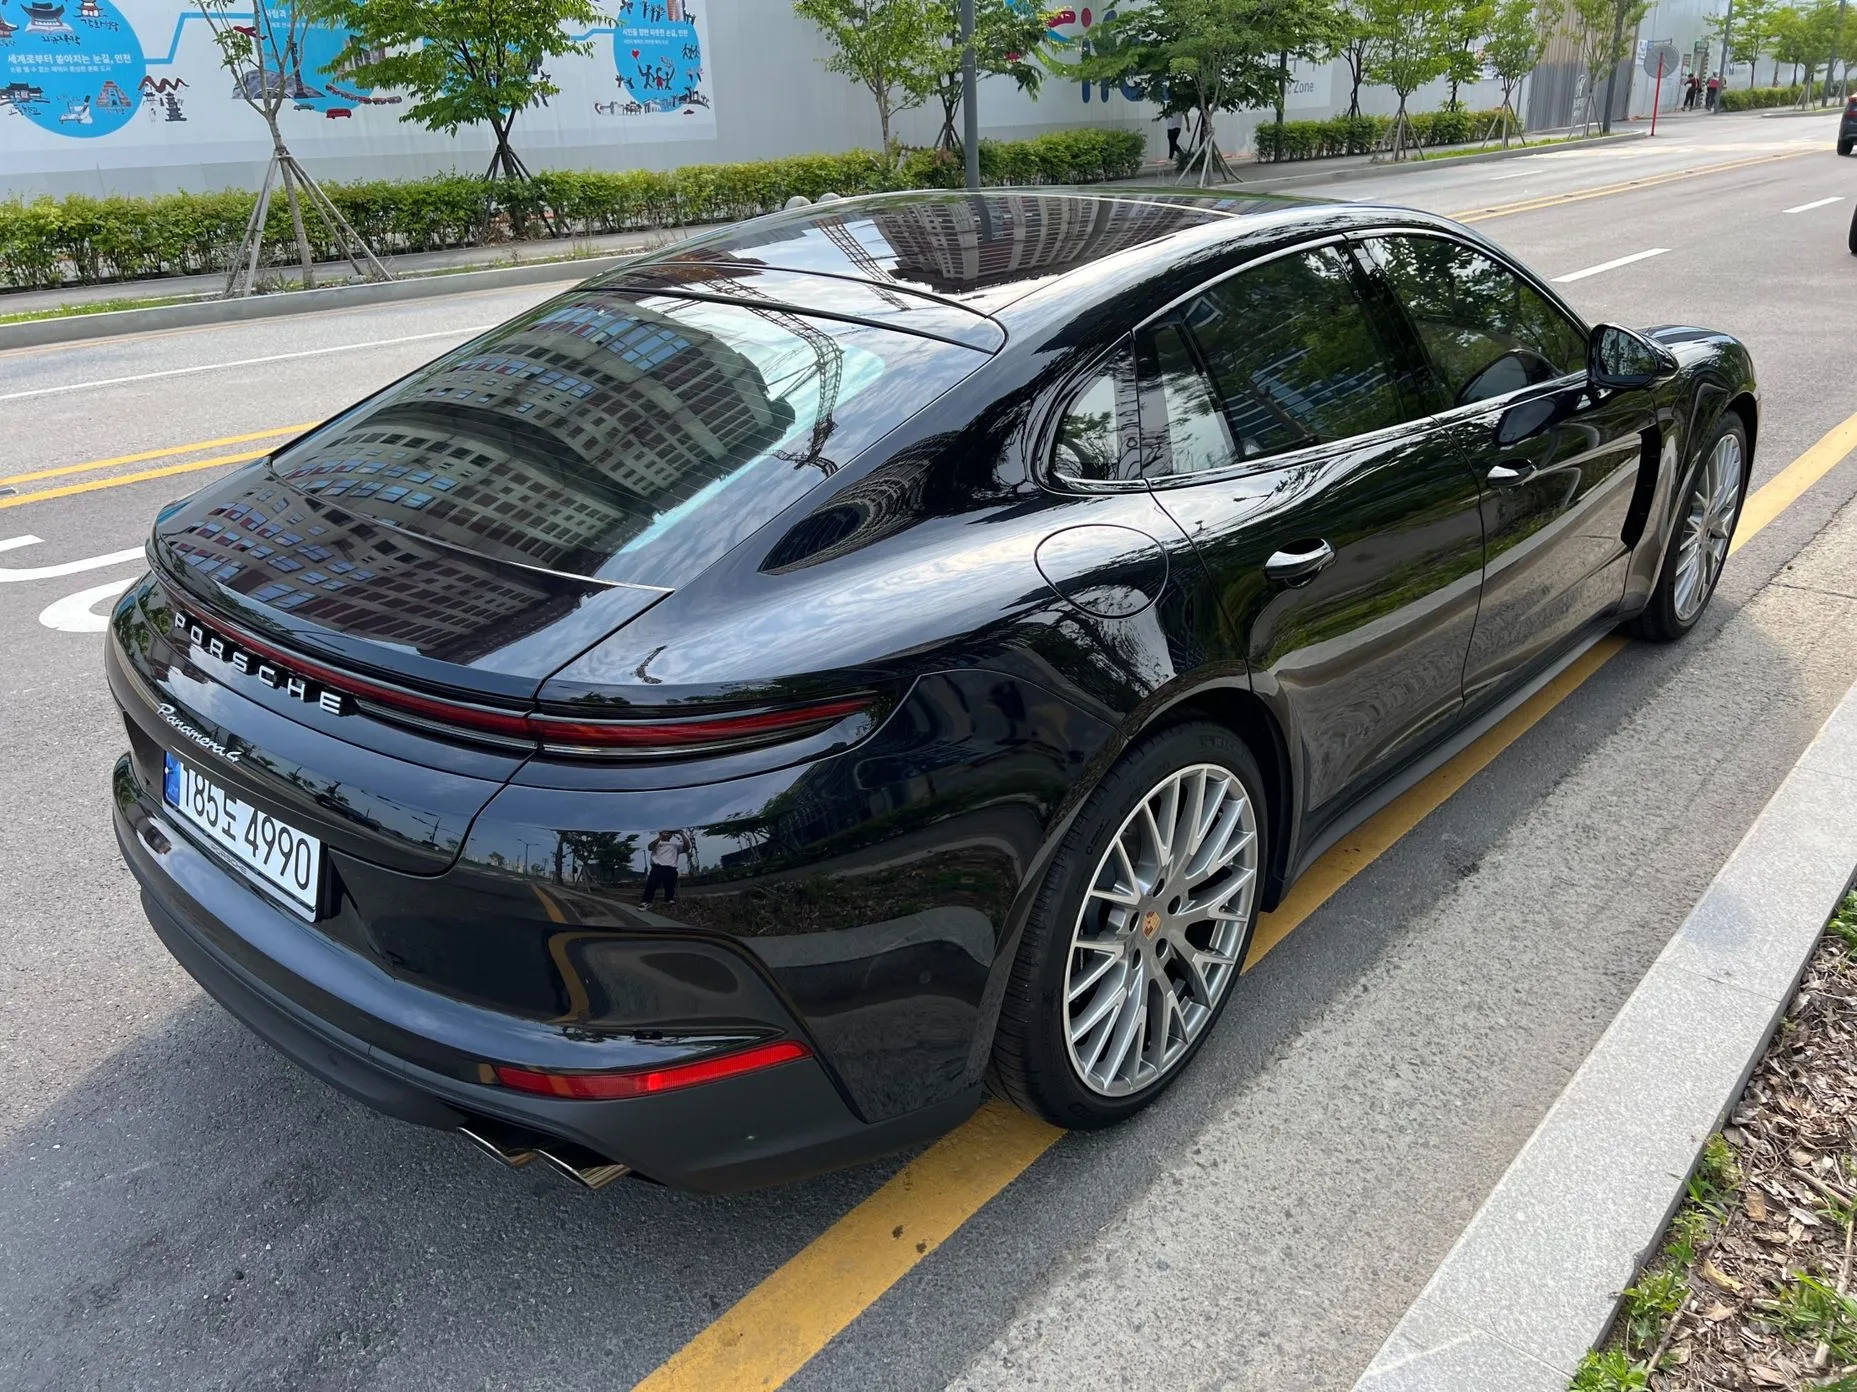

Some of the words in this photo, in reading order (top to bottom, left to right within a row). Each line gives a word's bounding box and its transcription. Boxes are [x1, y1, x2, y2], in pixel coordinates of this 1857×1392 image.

[1294, 80, 1314, 94] Zone
[174, 611, 343, 715] PORSCHE
[157, 702, 226, 757] Panamera
[226, 748, 241, 763] 4
[181, 760, 238, 841] 185도
[244, 809, 312, 891] 4990
